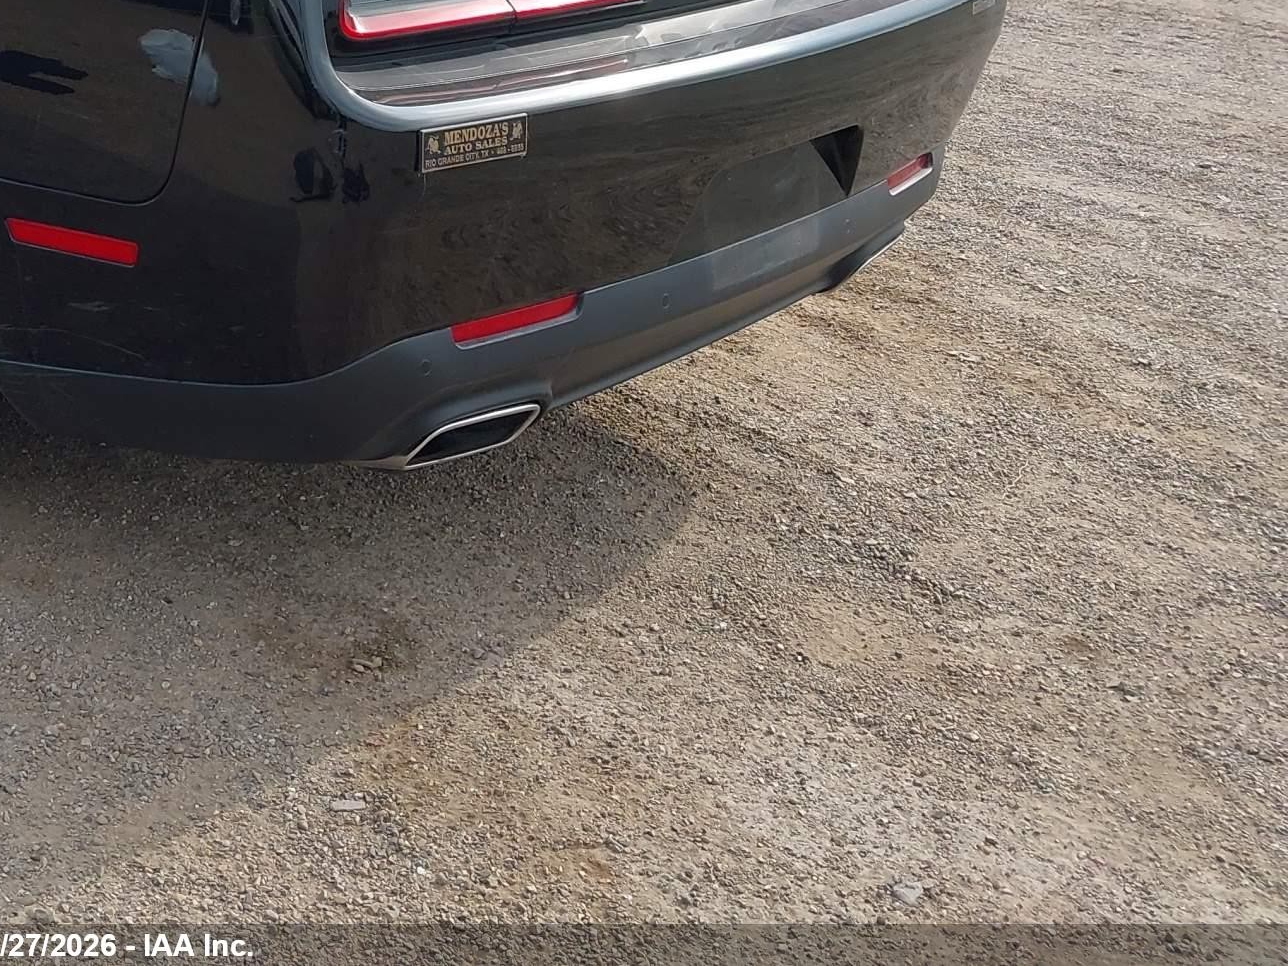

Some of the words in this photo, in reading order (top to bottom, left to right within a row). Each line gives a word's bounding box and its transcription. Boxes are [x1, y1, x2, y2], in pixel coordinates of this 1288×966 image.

[444, 121, 509, 146] MENDOZA'S
[444, 143, 473, 156] AUTO
[475, 136, 508, 150] SALES
[425, 158, 437, 169] RIO
[437, 154, 465, 166] GRANDE
[481, 150, 489, 159] TX
